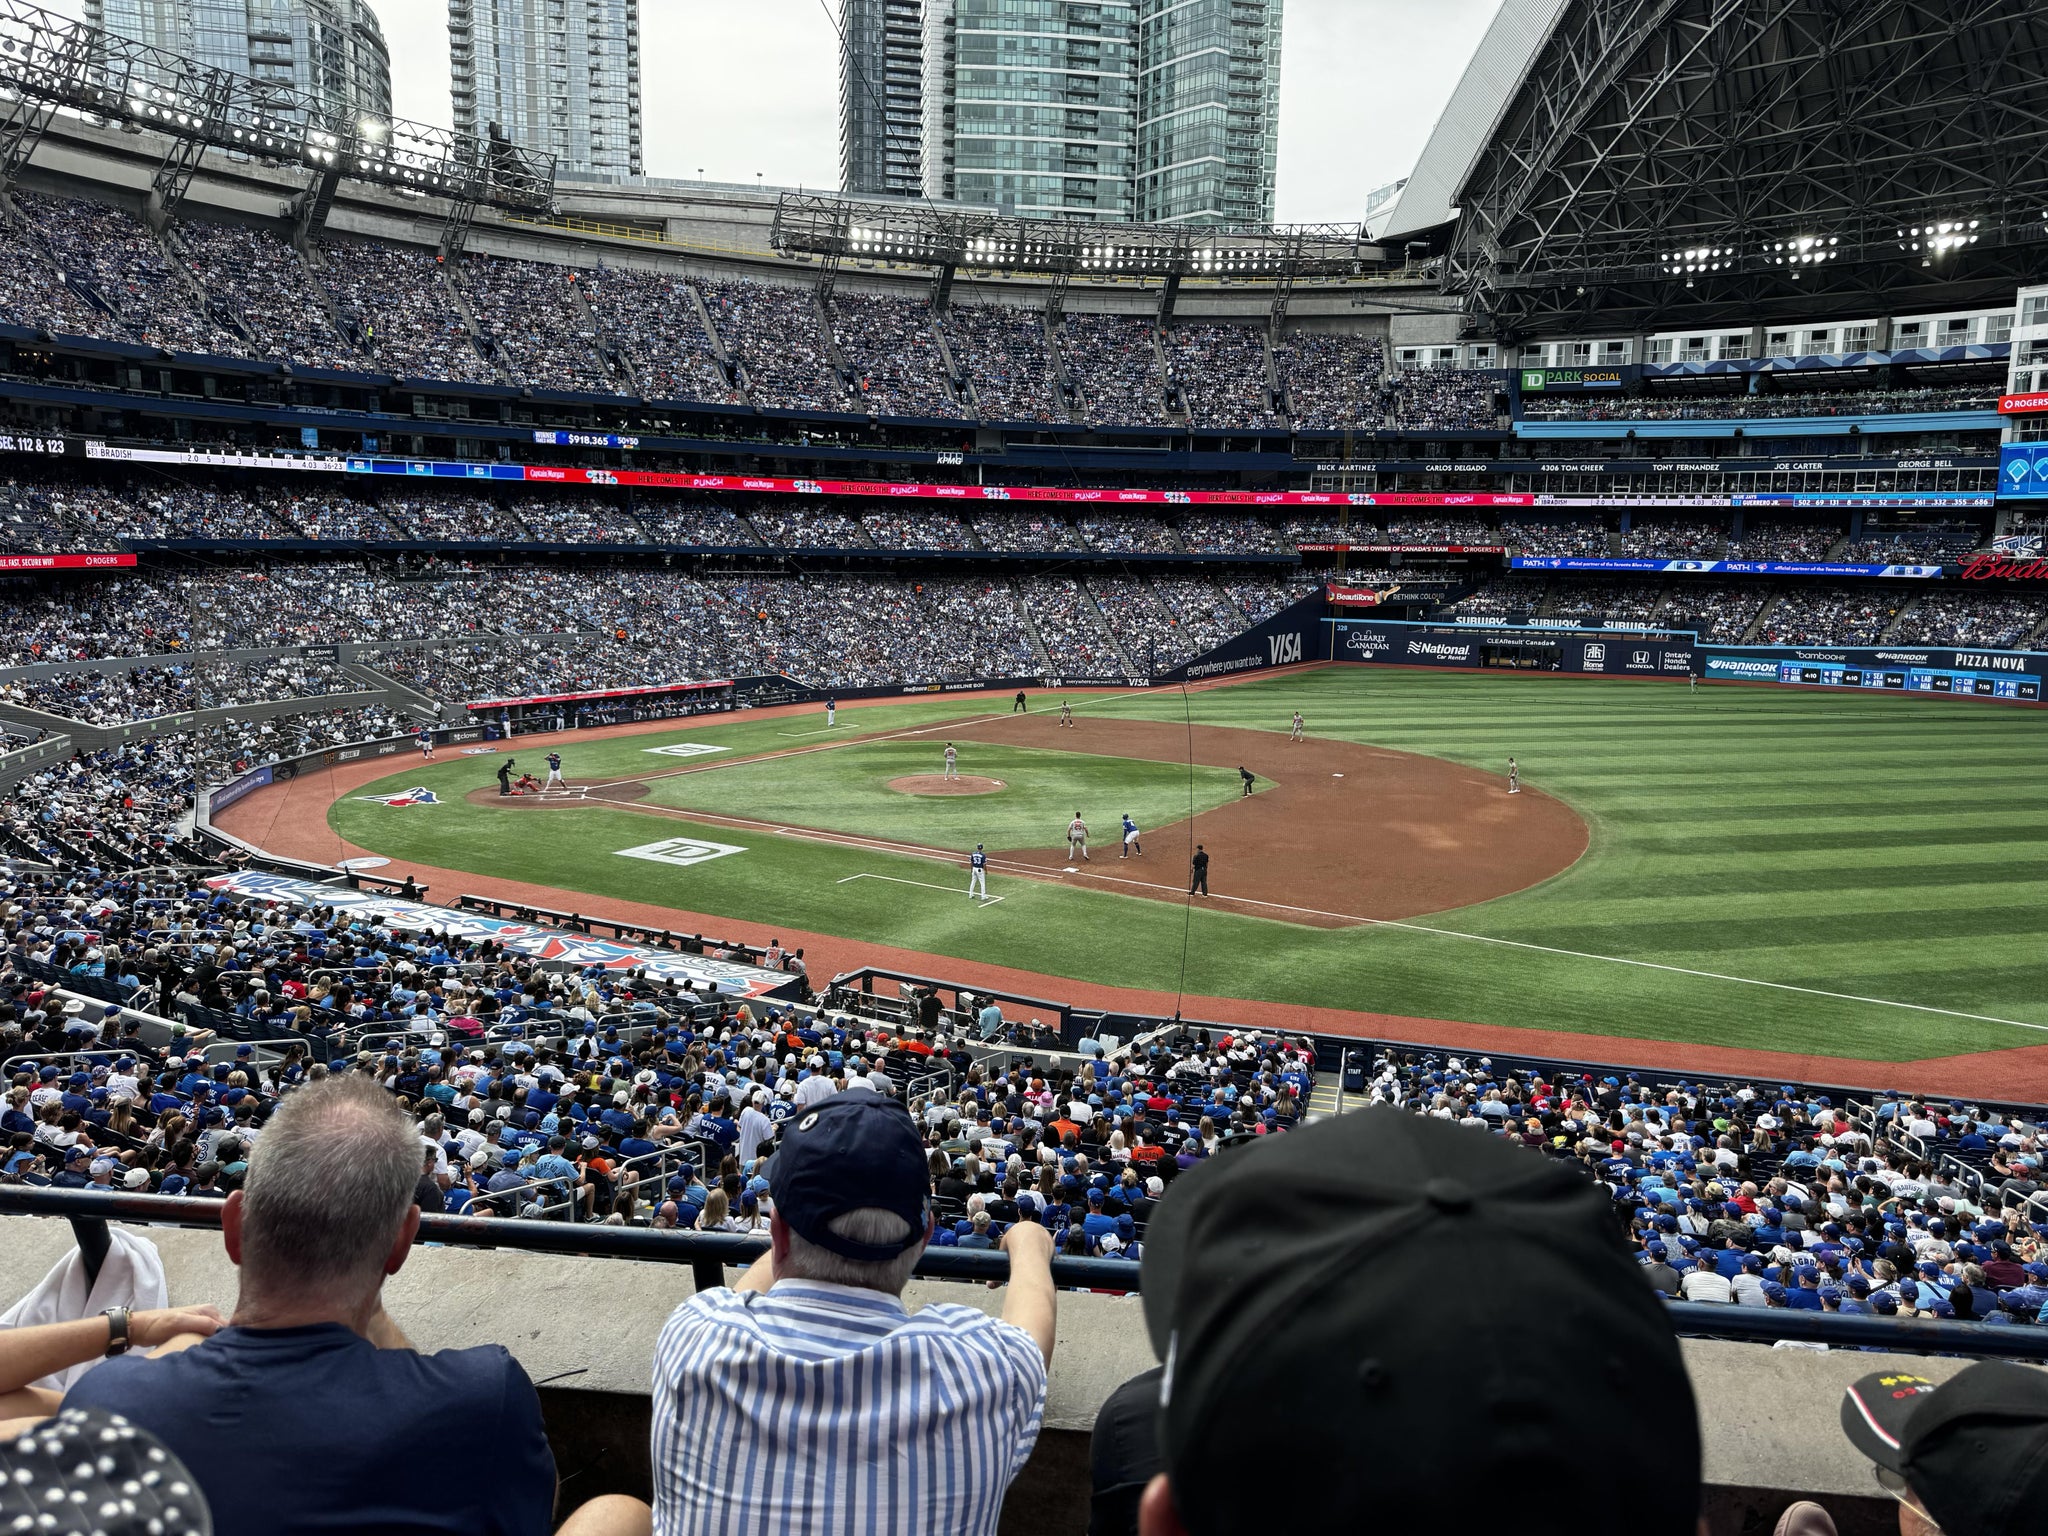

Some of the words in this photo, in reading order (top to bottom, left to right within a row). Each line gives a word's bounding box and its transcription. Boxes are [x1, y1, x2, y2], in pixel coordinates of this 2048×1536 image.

[1526, 374, 1542, 387] TD
[1546, 371, 1582, 382] PARK
[1583, 373, 1621, 381] SOCIAL
[2014, 398, 2048, 408] ROGERS
[18, 437, 33, 451] 112
[36, 439, 44, 452] &
[46, 440, 64, 454] 123
[100, 449, 132, 459] BRADISH
[323, 462, 343, 470] 36-23
[694, 478, 724, 486] PUNCH
[1336, 593, 1374, 601] BeautiTone
[1456, 616, 1506, 626] SUBWAY
[1527, 619, 1581, 628] SUBWAY
[1352, 632, 1386, 642] CLEARLY
[1268, 632, 1301, 665] VISA
[1347, 640, 1389, 650] CANADIAN
[1187, 660, 1222, 677] everywhere
[1223, 659, 1234, 673] you
[1234, 657, 1248, 667] want
[1249, 656, 1254, 666] to
[1254, 656, 1262, 665] be
[1955, 653, 1989, 668] PIZZA
[1993, 656, 2025, 671] NOVA
[460, 731, 478, 740] clover
[770, 1108, 786, 1120] 19
[1664, 1159, 1676, 1170] 19
[1938, 1277, 1955, 1286] KIRK
